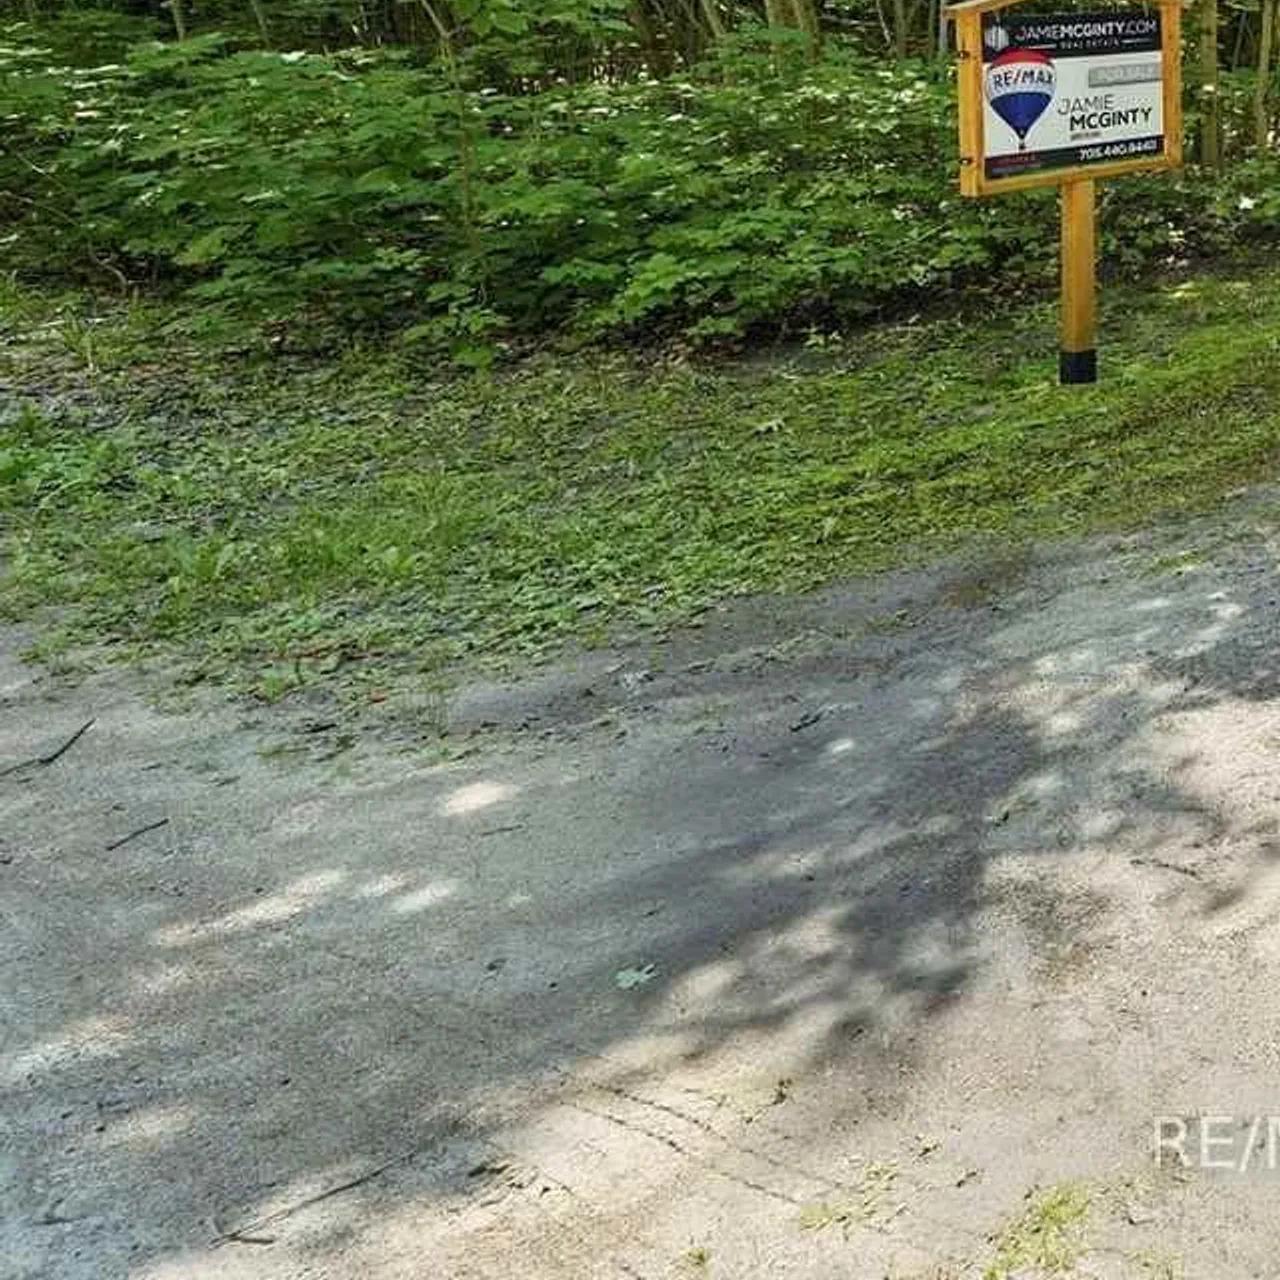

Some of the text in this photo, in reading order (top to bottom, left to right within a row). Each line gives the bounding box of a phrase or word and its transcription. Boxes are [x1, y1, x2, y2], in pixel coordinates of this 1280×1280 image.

[1015, 21, 1156, 39] JAMIEMCGINTY.COM
[992, 69, 1054, 90] RE/MAX
[1058, 94, 1114, 115] JAMIE
[1070, 108, 1152, 131] MCGINTY
